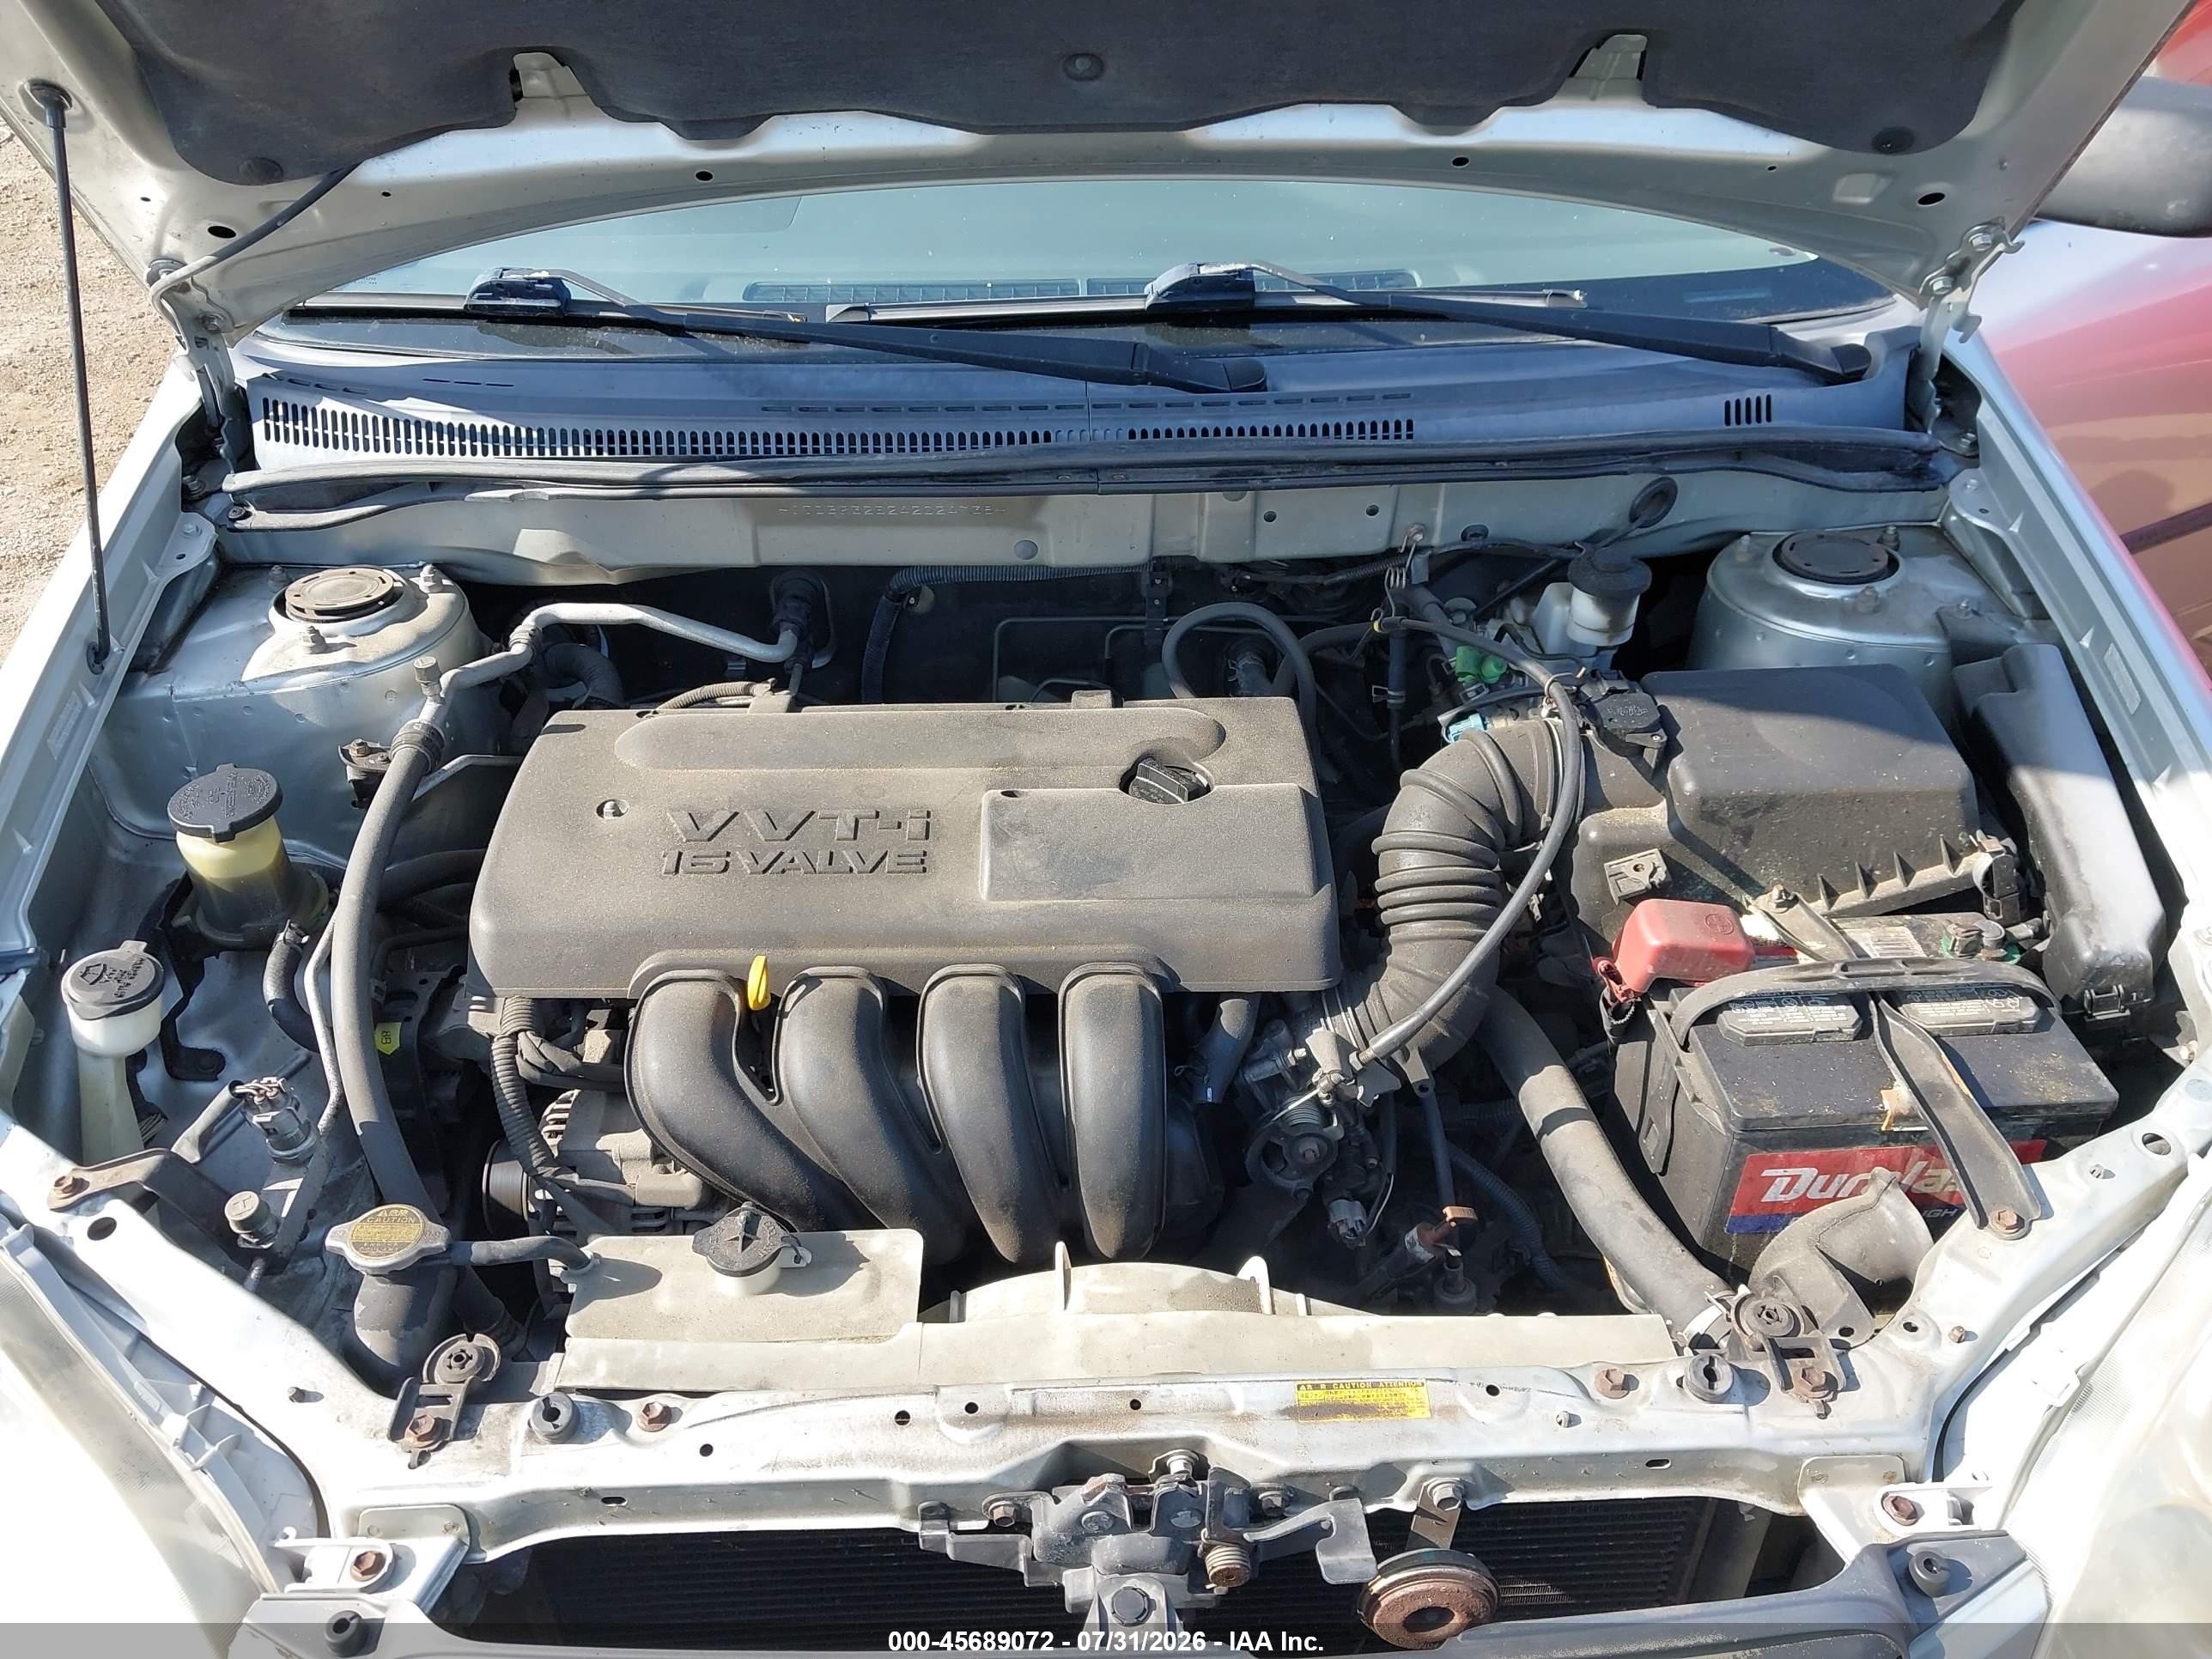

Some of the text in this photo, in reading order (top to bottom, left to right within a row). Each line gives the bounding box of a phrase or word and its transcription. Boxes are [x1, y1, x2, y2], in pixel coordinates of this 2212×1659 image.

[666, 809, 932, 842] VVT-i
[660, 849, 927, 875] 16 VALVE
